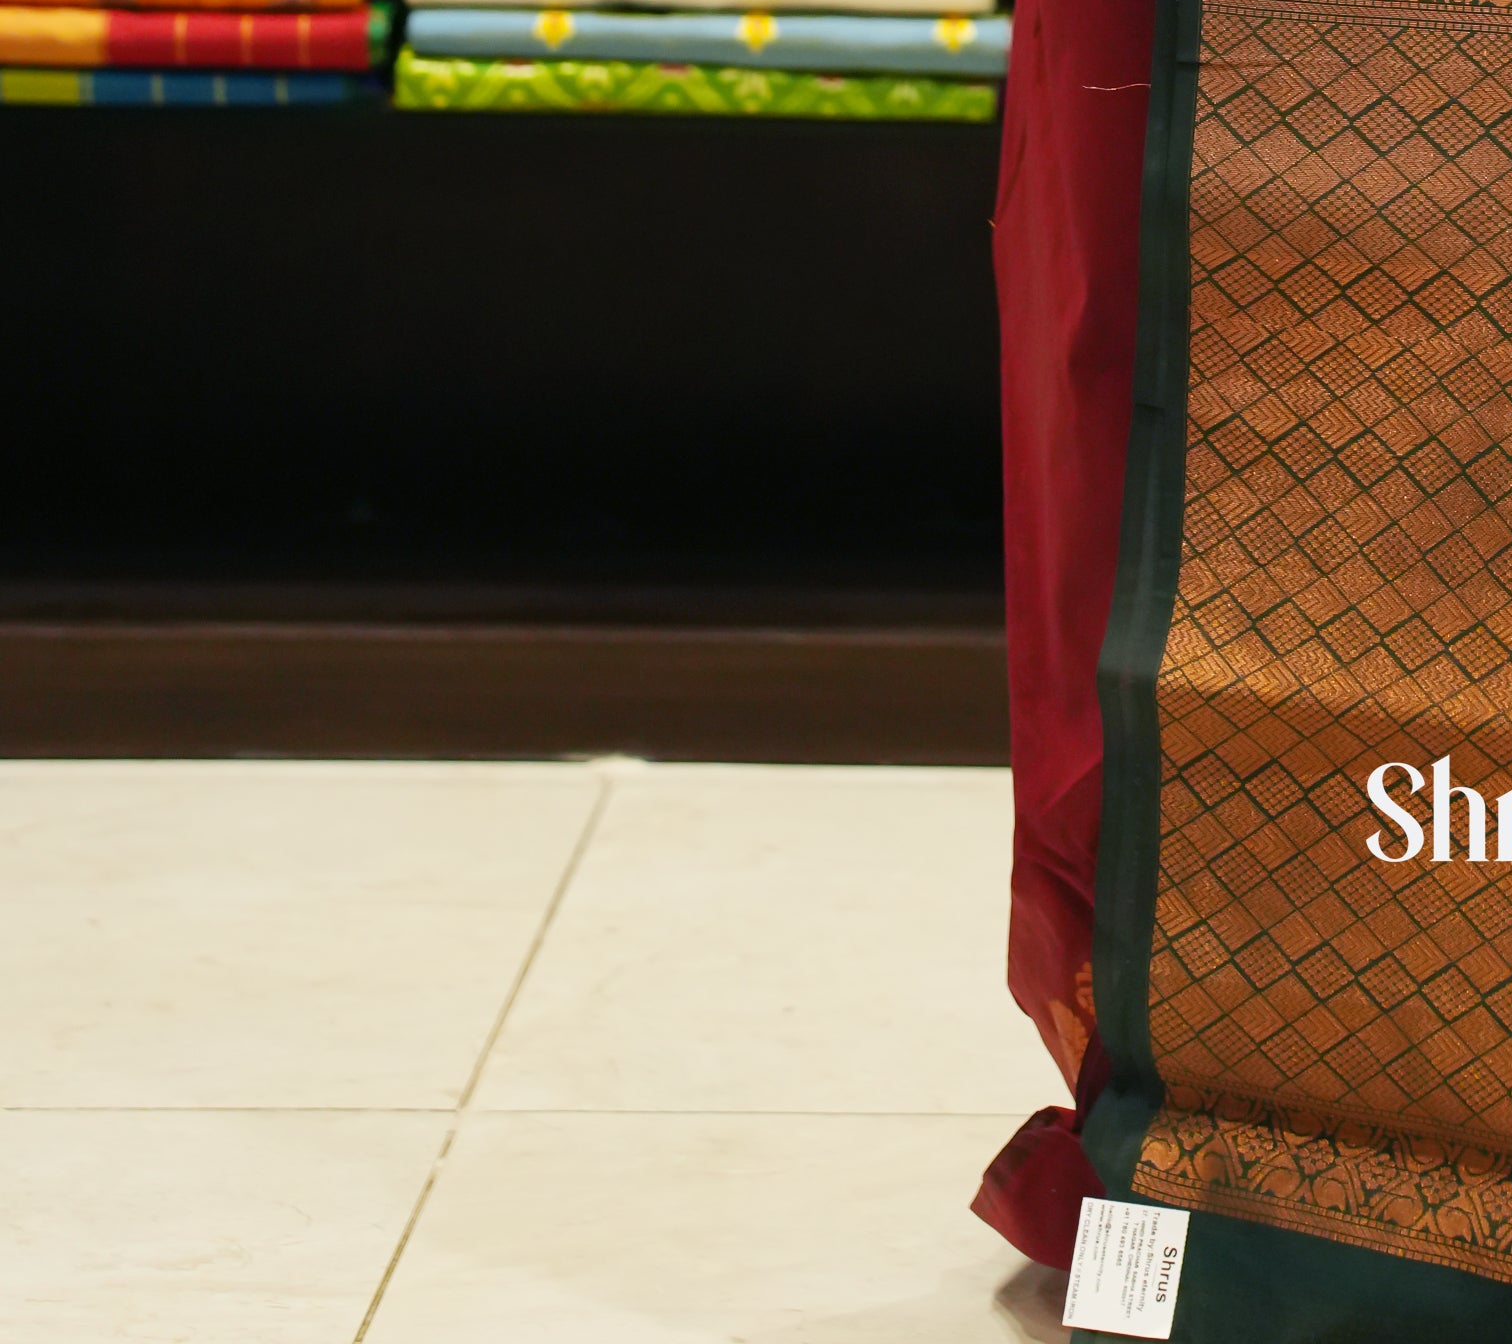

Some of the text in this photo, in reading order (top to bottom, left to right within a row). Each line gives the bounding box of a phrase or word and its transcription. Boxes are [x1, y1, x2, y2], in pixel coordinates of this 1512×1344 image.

[1080, 1219, 1091, 1245] CLEAN
[1150, 1212, 1161, 1236] Trade
[1077, 1246, 1086, 1266] ONLY
[1143, 1252, 1155, 1277] Shrus
[1071, 1274, 1081, 1300] STEAM
[1155, 1246, 1178, 1303] Shrus
[1135, 1279, 1148, 1312] eternity
